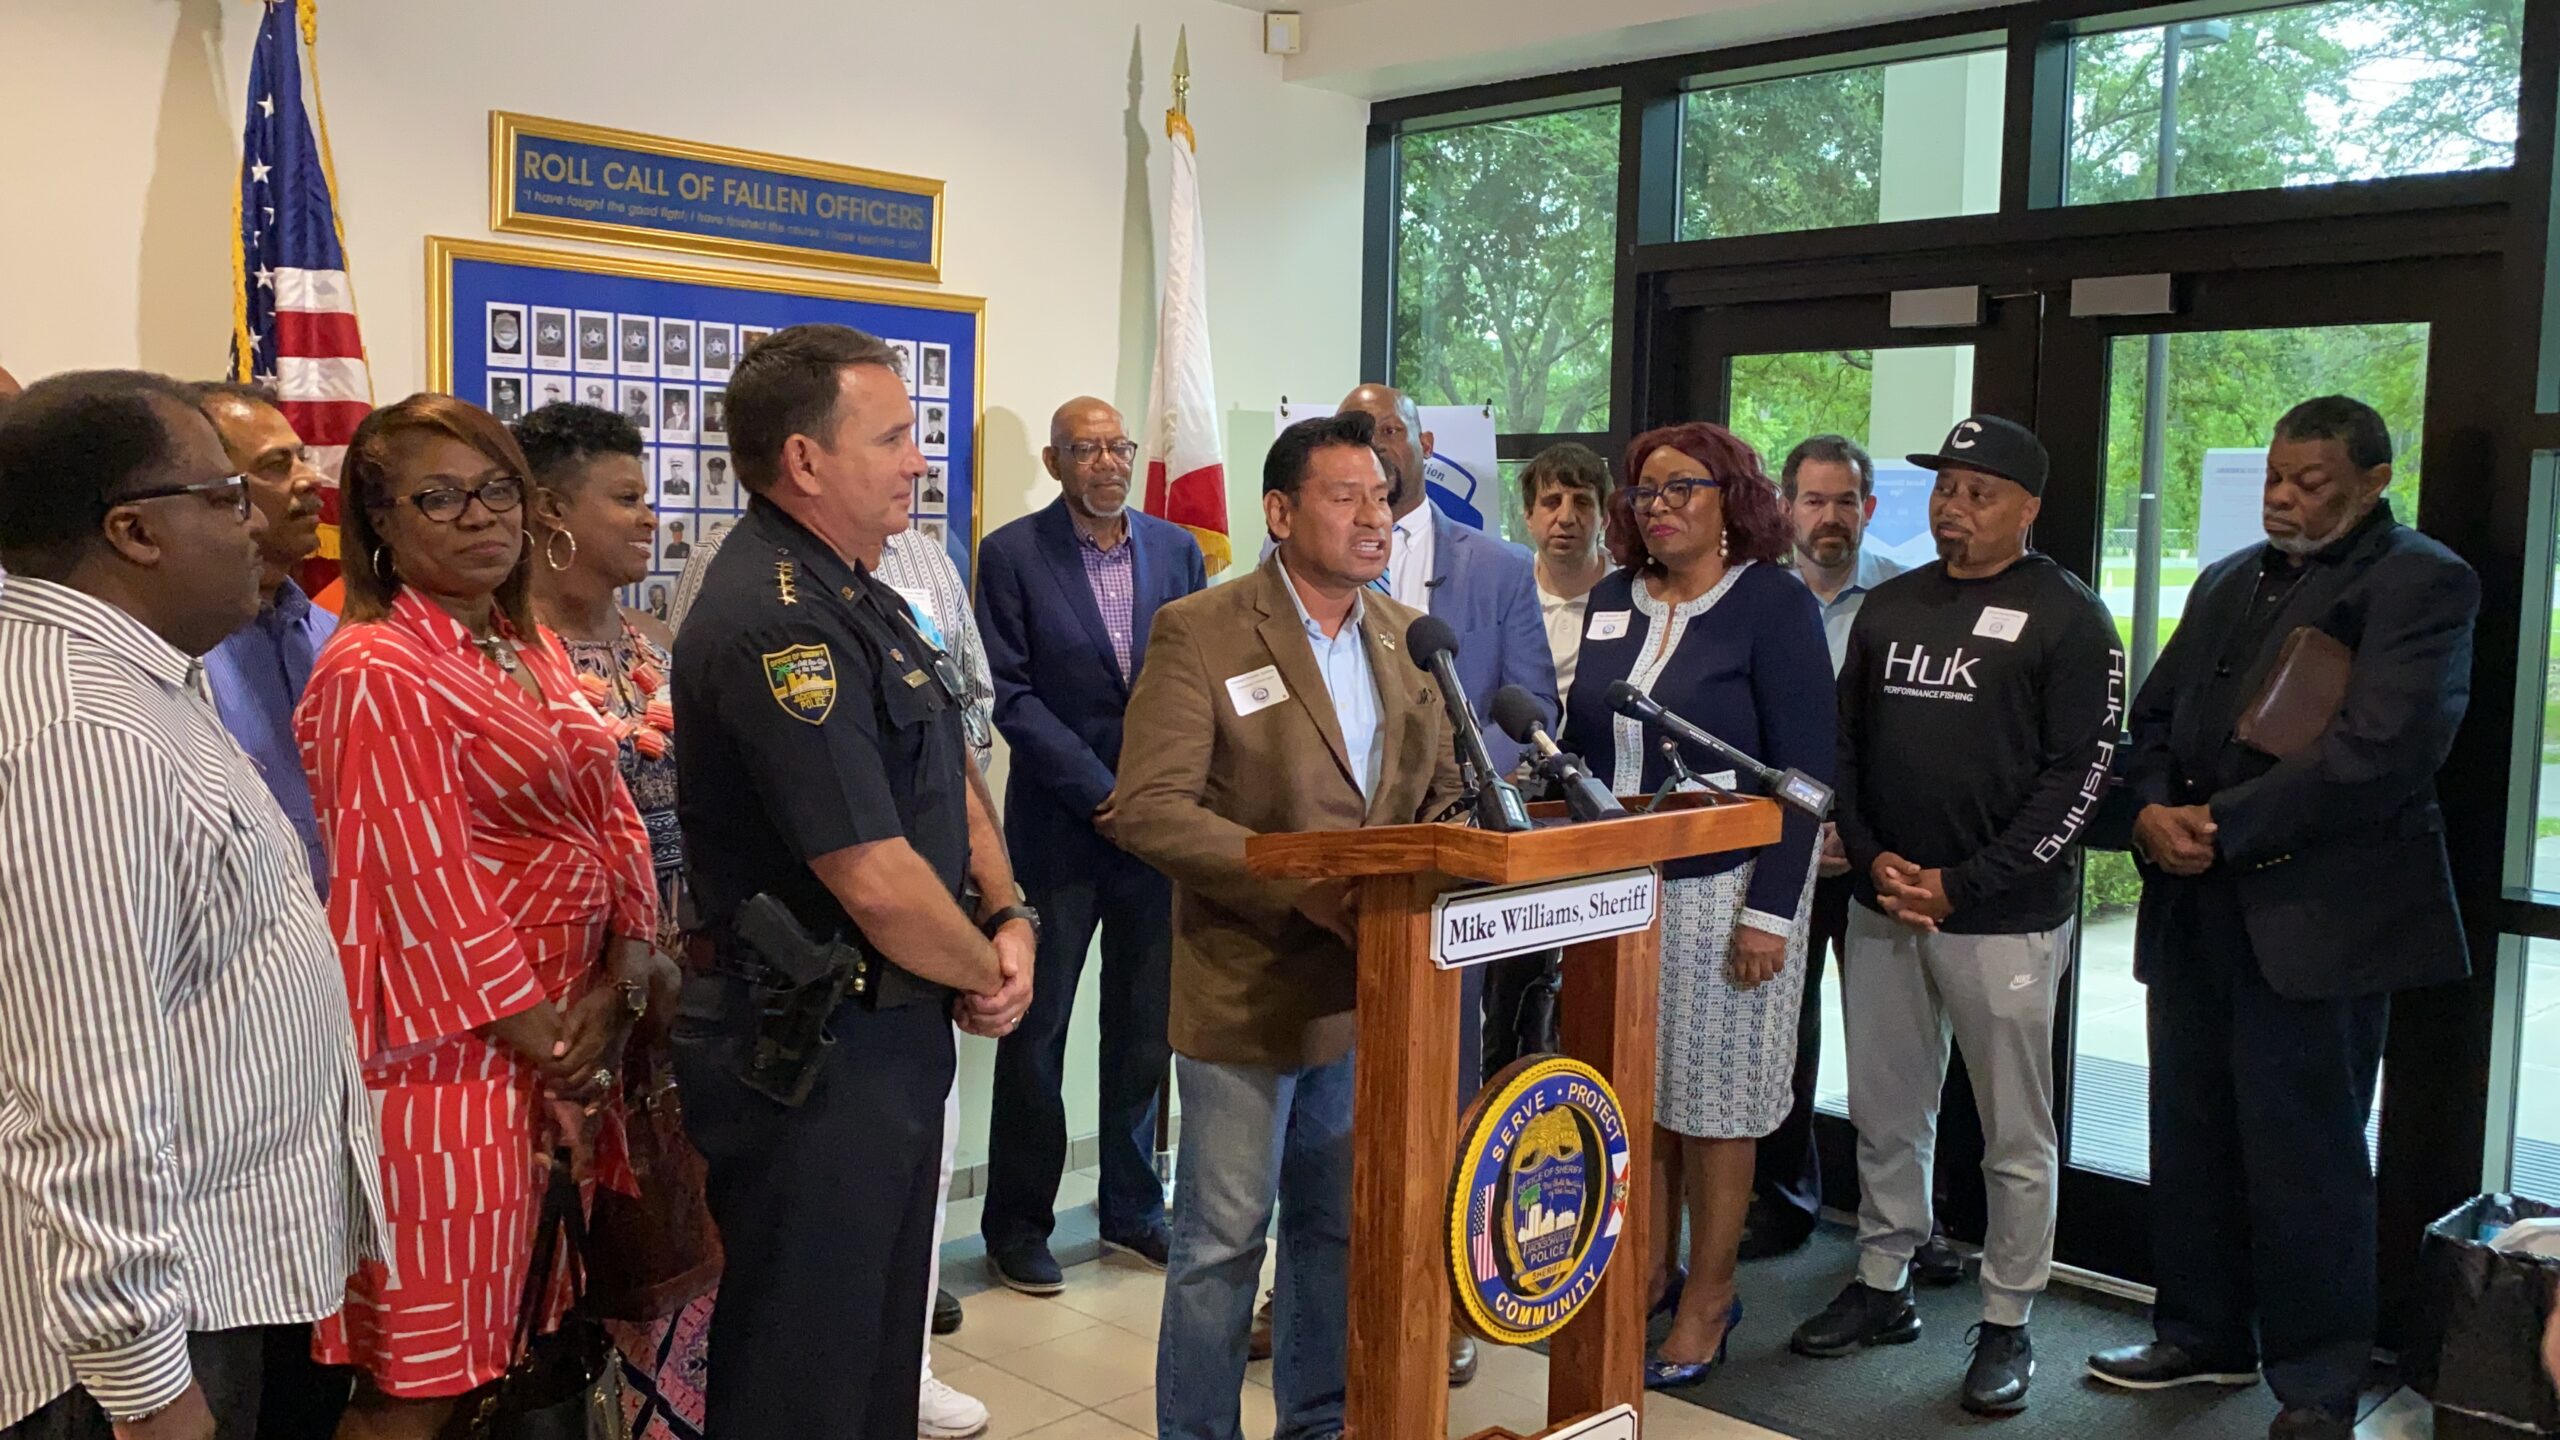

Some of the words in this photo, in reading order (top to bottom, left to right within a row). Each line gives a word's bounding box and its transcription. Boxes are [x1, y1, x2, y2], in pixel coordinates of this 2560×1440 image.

[523, 150, 594, 187] ROLL
[603, 162, 670, 197] CALL
[678, 172, 715, 202] OF
[723, 178, 808, 216] FALLEN
[815, 191, 925, 231] OFFICERS
[534, 190, 564, 205] have
[628, 204, 659, 218] good
[1951, 421, 1983, 449] C
[800, 697, 827, 711] POLICE
[1883, 685, 1940, 699] PERFORMANCE
[1939, 690, 1974, 702] FISHING
[1448, 914, 1497, 946] Mike
[1501, 902, 1584, 937] Williams,
[1588, 884, 1648, 920] Sheriff
[1491, 1089, 1546, 1163] SERVE
[1567, 1081, 1622, 1142] PROTECT
[1517, 1171, 1543, 1195] OFFICE
[1543, 1167, 1554, 1178] OF
[1554, 1164, 1583, 1175] SHERIFF
[1526, 1229, 1574, 1255] JACKSONVILLE
[1530, 1243, 1566, 1265] POLICE
[1532, 1262, 1562, 1281] SHERIFF
[1495, 1262, 1598, 1327] COMMUNITY
